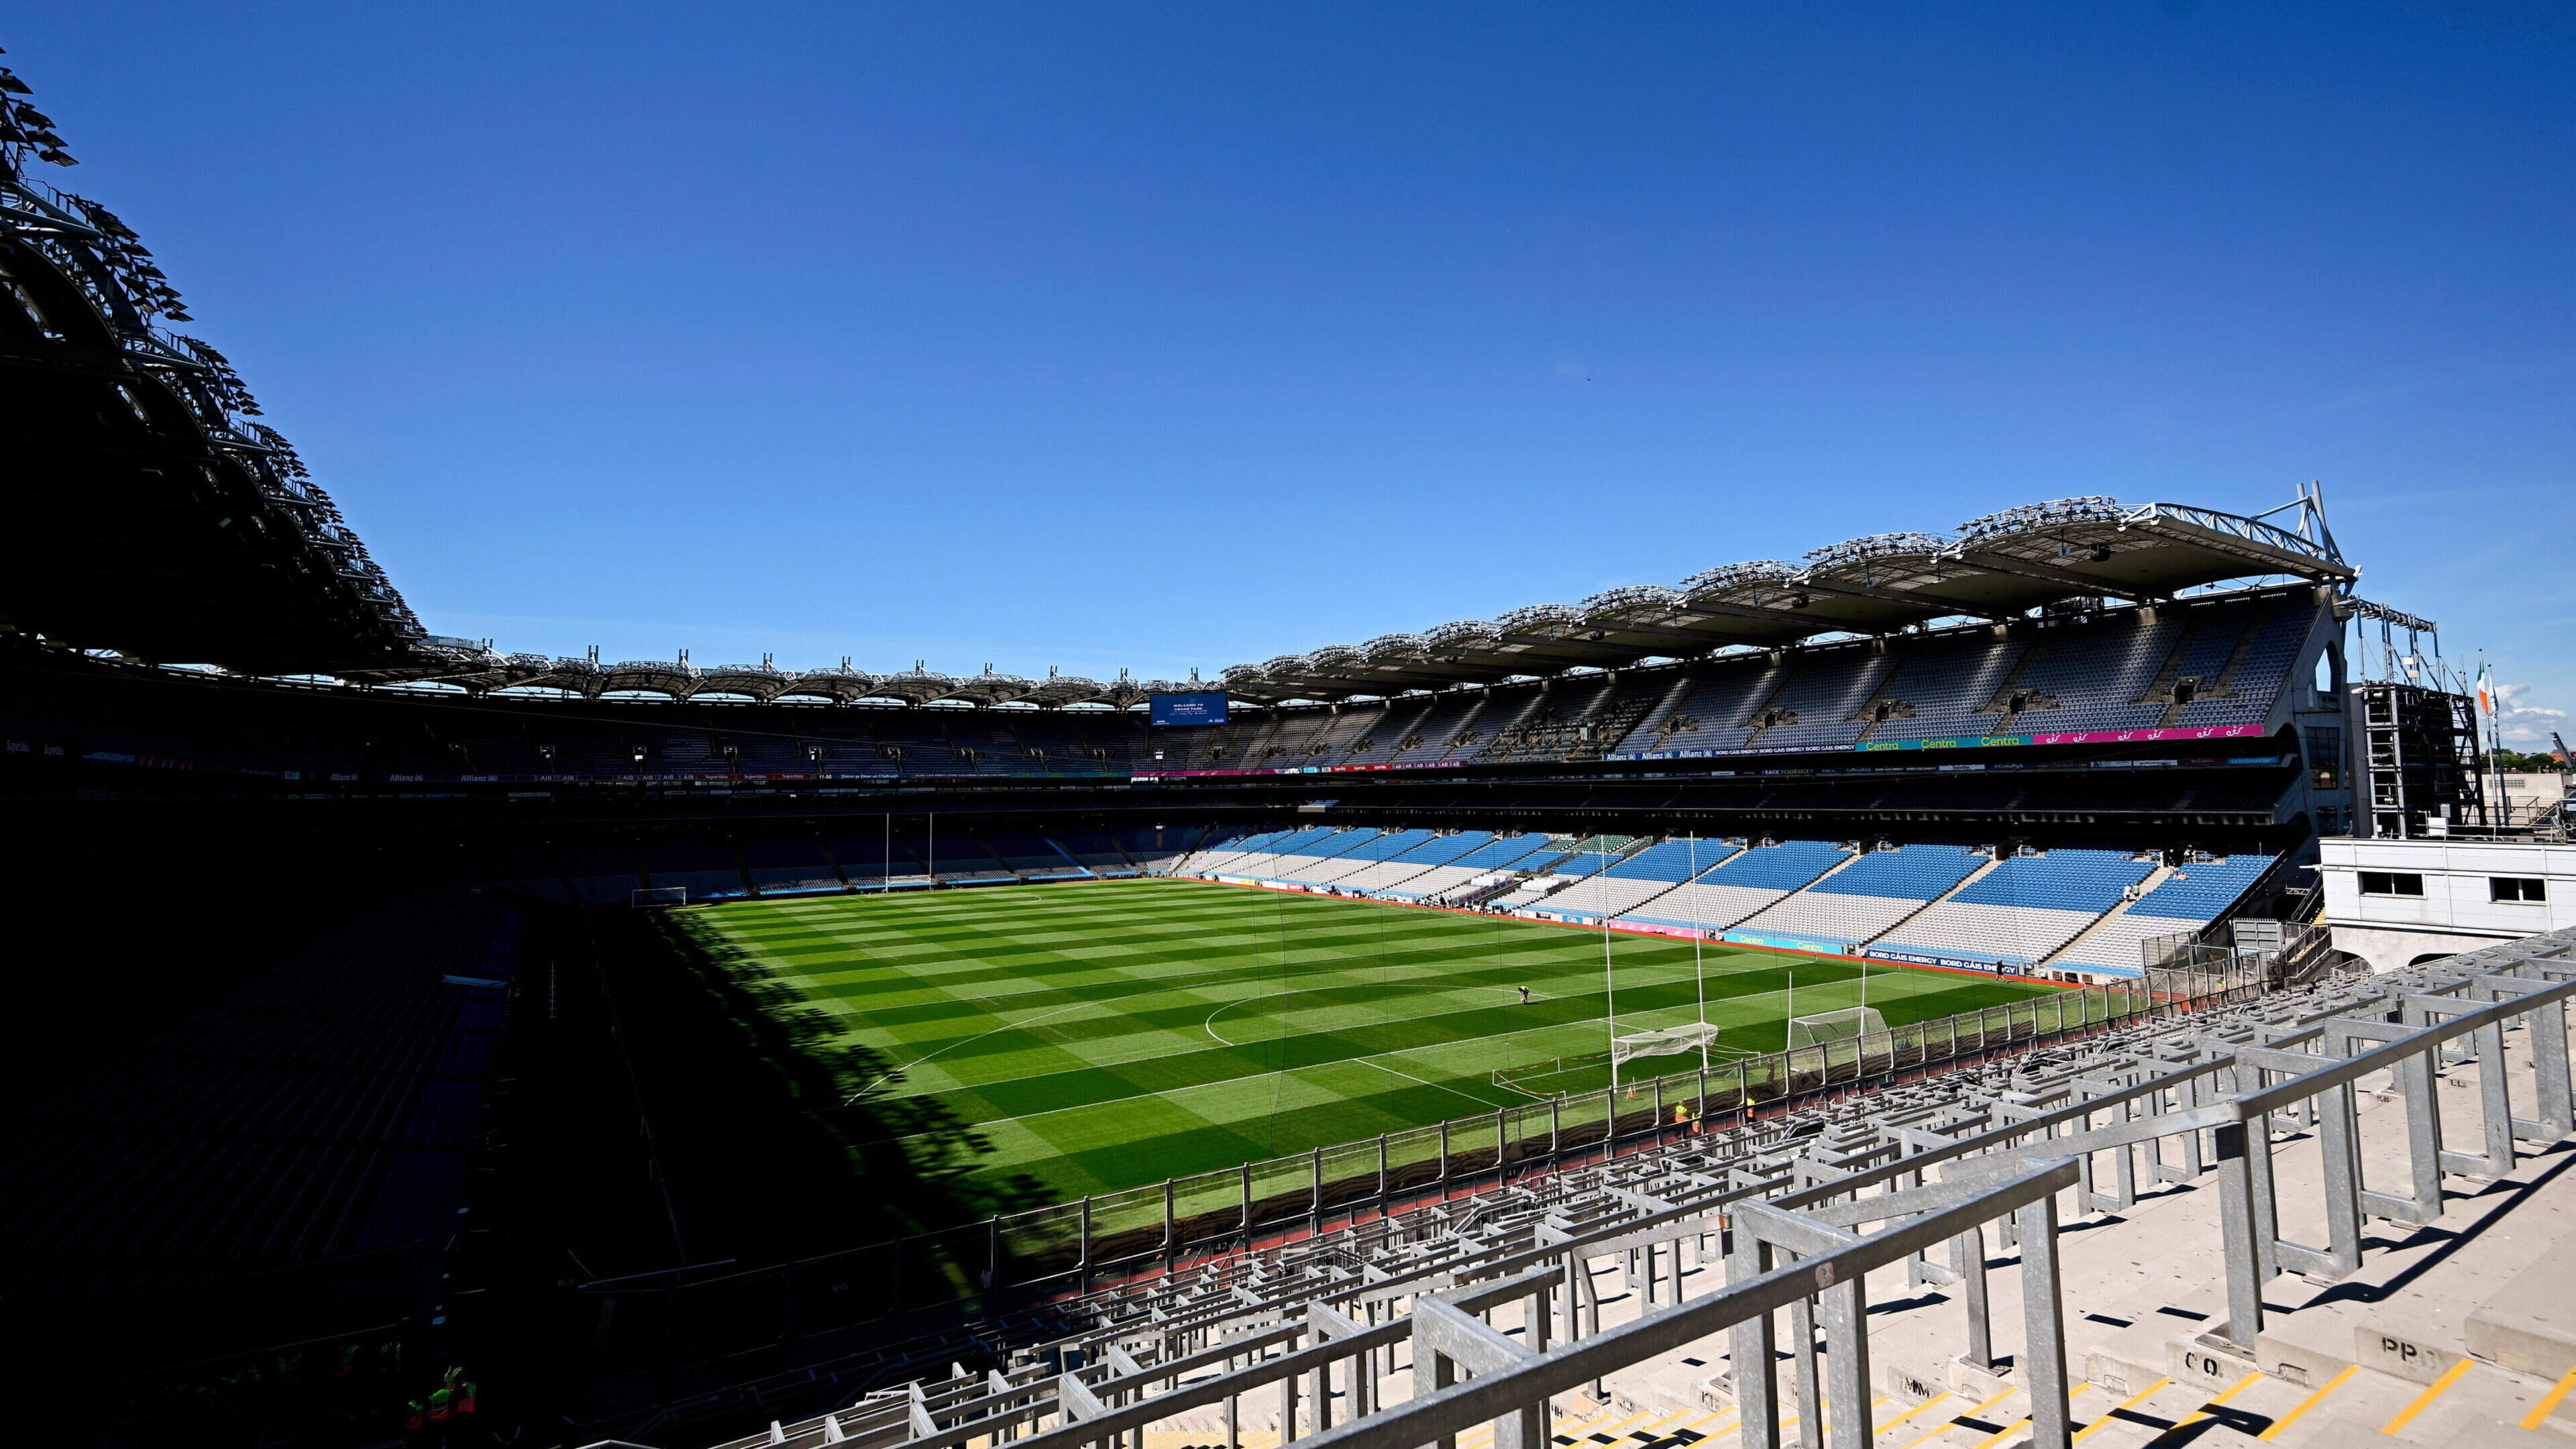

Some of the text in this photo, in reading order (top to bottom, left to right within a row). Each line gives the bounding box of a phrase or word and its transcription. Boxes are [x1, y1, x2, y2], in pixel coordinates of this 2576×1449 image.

[1866, 742, 1898, 751] Centra
[1921, 739, 1956, 749] Centra
[1981, 737, 2019, 746] Centra
[1642, 751, 1663, 759] Allianz
[1680, 750, 1703, 758] Allianz
[1739, 935, 1764, 945] Centra
[1798, 942, 1823, 952] Centra
[1870, 951, 1937, 965] BORD GÁIS ENERGY
[1940, 959, 1963, 967] BORD
[1964, 961, 1982, 969] GÁIS
[1216, 1242, 1228, 1250] 42
[2382, 1336, 2418, 1362] PP
